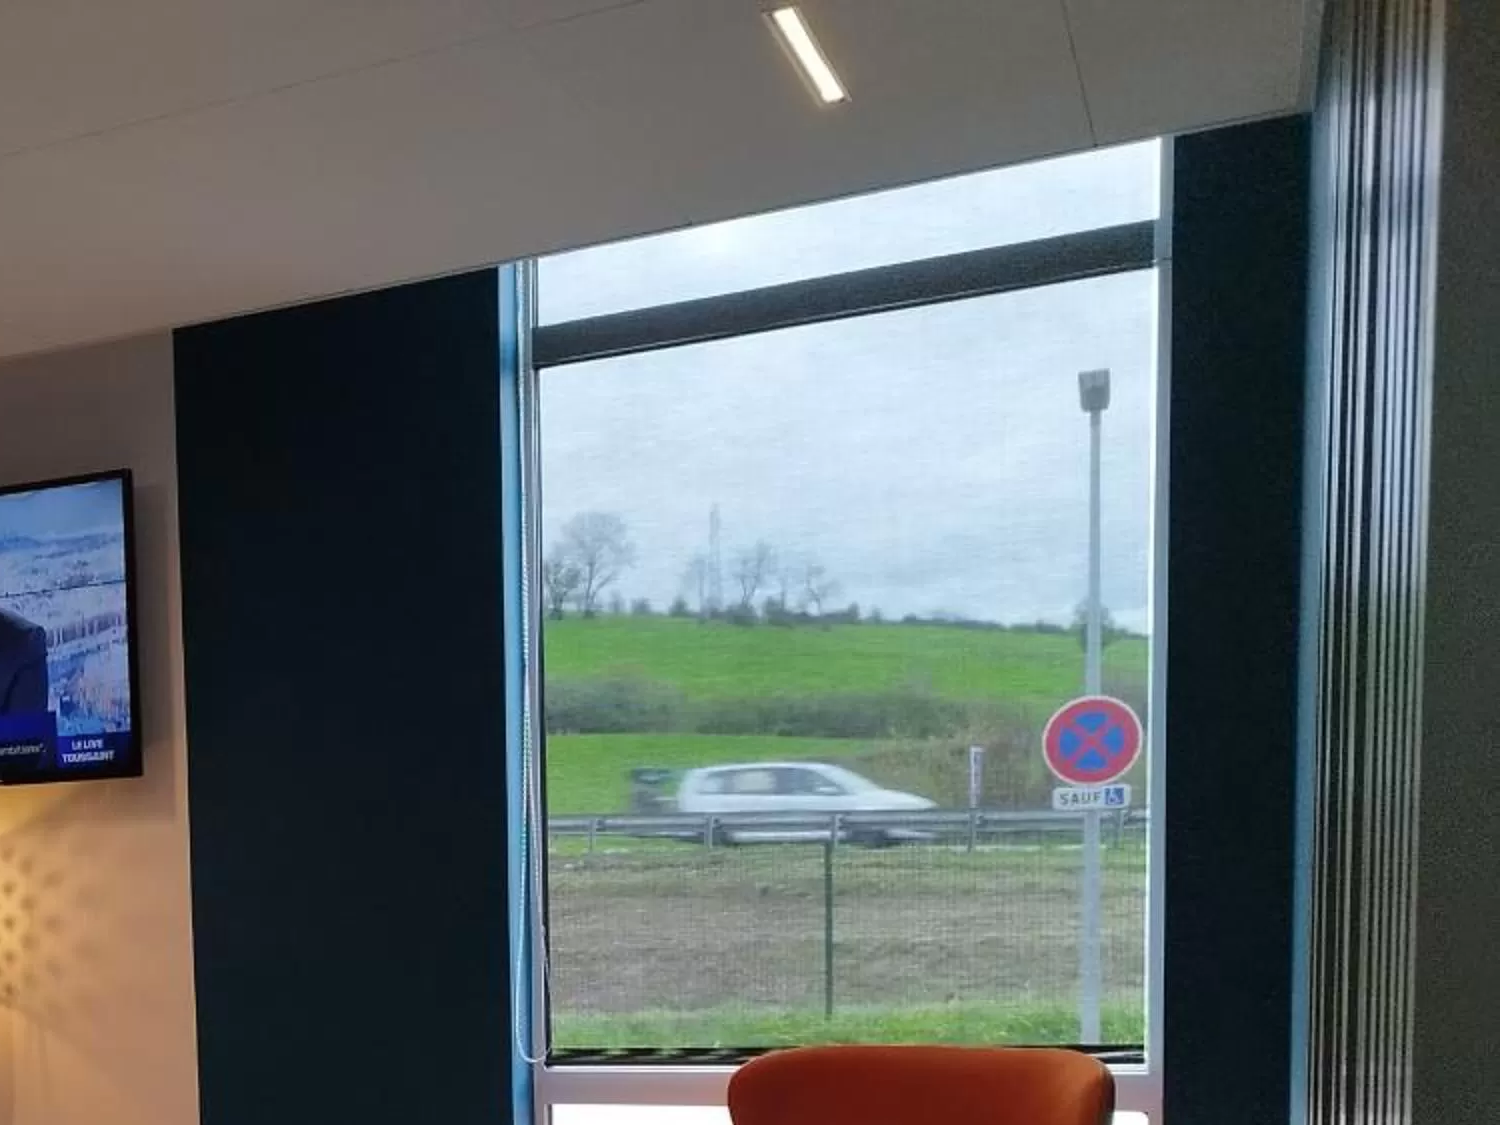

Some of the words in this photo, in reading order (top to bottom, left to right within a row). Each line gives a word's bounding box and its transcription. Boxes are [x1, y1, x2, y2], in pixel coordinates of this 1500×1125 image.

[83, 737, 104, 750] LIVE
[61, 748, 115, 764] TOUSSAINT
[1059, 792, 1101, 805] SAUF
